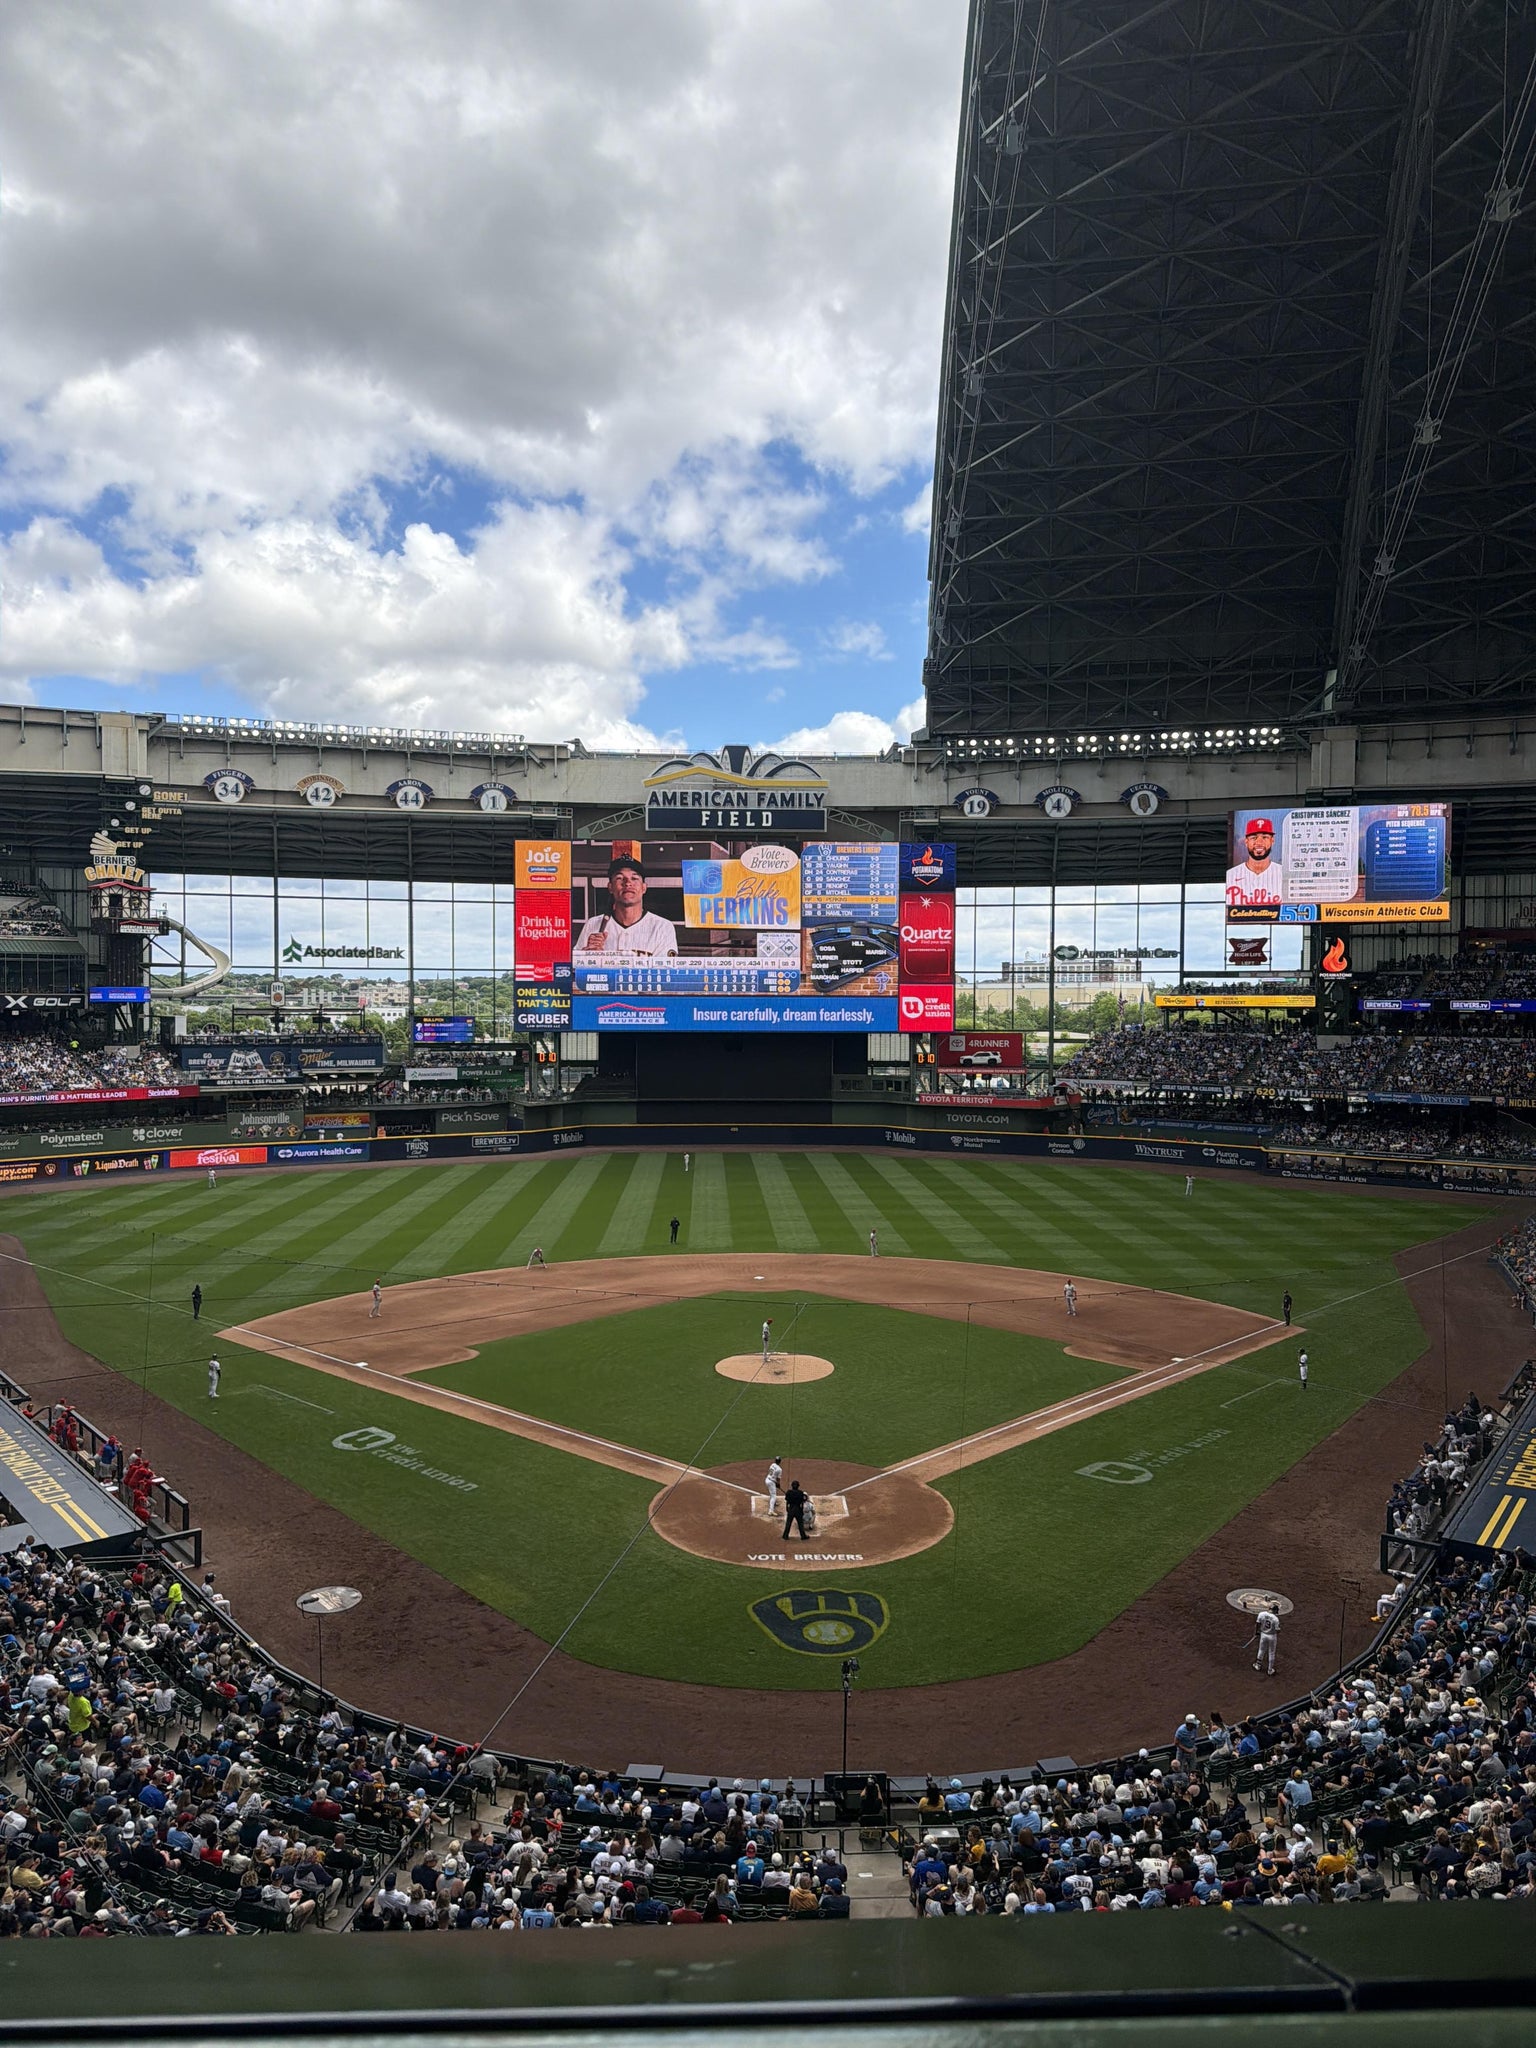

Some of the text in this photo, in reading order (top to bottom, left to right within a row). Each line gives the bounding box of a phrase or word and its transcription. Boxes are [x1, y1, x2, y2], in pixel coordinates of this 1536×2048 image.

[212, 770, 247, 781] FINGERS
[302, 775, 339, 787] ROBINSON
[218, 782, 242, 798] 34
[398, 780, 423, 788] AARON
[482, 783, 505, 791] SELIG
[1130, 785, 1158, 794] UECKER
[153, 791, 188, 801] GONE!
[309, 787, 332, 803] 42
[399, 791, 421, 805] 44
[965, 788, 989, 797] YOUNT
[1042, 787, 1076, 797] MOLITOR
[488, 794, 499, 810] 1
[648, 790, 825, 808] AMERICAN FAMILY
[141, 807, 183, 816] GET OUTTA
[966, 800, 987, 815] 19
[1051, 800, 1063, 813] 4
[701, 810, 773, 827] FIELD
[1291, 809, 1351, 820] CRISTOPHER SÁNCHEZ
[1401, 820, 1426, 828] SEQUENCE
[124, 826, 153, 835] GET UP
[132, 841, 144, 849] UP
[525, 847, 561, 864] Joie
[760, 847, 781, 860] Vote
[94, 855, 137, 866] BERNIE'S
[750, 857, 790, 870] Brewers
[84, 865, 146, 883] CHALET
[734, 877, 780, 904] Blake
[699, 897, 789, 926] PERKINS
[1230, 903, 1443, 922] Celebrating 50 Wisconsin Athletic Club
[521, 915, 565, 927] Drink in
[518, 926, 569, 940] Together
[900, 925, 953, 944] Quartz
[1084, 947, 1178, 959] Aurora Health Care
[517, 988, 538, 997] ONE
[33, 997, 82, 1007] GOLF
[516, 999, 571, 1008] THAT'S ALL!
[925, 1003, 951, 1011] credit
[517, 1013, 569, 1025] GRUBER
[693, 1007, 875, 1024] Insure carefully, dream fearlessly.
[968, 1039, 1010, 1048] 4RUNNER
[298, 1051, 334, 1065] Miller
[317, 1059, 376, 1067] TIME, MILWAUKEE
[20, 1093, 59, 1102] FURNITURE
[66, 1092, 101, 1100] MATTRESS
[102, 1091, 128, 1099] LEADER
[1256, 1087, 1309, 1098] 620 WTMJ
[921, 1095, 994, 1105] TOYOTA TERRITORY
[1419, 1095, 1465, 1104] WINTRUST
[240, 1112, 290, 1126] Johnsonville
[307, 1117, 344, 1127] Surfside
[441, 1112, 463, 1122] Pick
[473, 1112, 500, 1122] Save
[946, 1113, 1009, 1125] TOYOTA.COM
[40, 1132, 104, 1145] Polymatech
[146, 1127, 183, 1139] clover
[560, 1132, 584, 1144] Mobile
[892, 1132, 917, 1144] Mobile
[474, 1136, 517, 1146] BREWERS.TV
[963, 1136, 1000, 1144] Northwestern
[320, 1148, 344, 1156] Health
[405, 1141, 429, 1152] TRUSS
[1135, 1144, 1186, 1157] WINTRUST
[197, 1150, 240, 1165] festival
[1216, 1150, 1239, 1158] Aurora
[95, 1159, 139, 1172] Liquid Death
[1216, 1157, 1256, 1166] Health Care
[1339, 1175, 1367, 1183] BULLPEN
[371, 1449, 479, 1493] credit union
[24, 1476, 72, 1504] FIELD
[747, 1553, 864, 1561] VOTE BREWERS
[1264, 1620, 1272, 1629] 3
[747, 1865, 755, 1879] 7
[527, 1917, 545, 1929] 19
